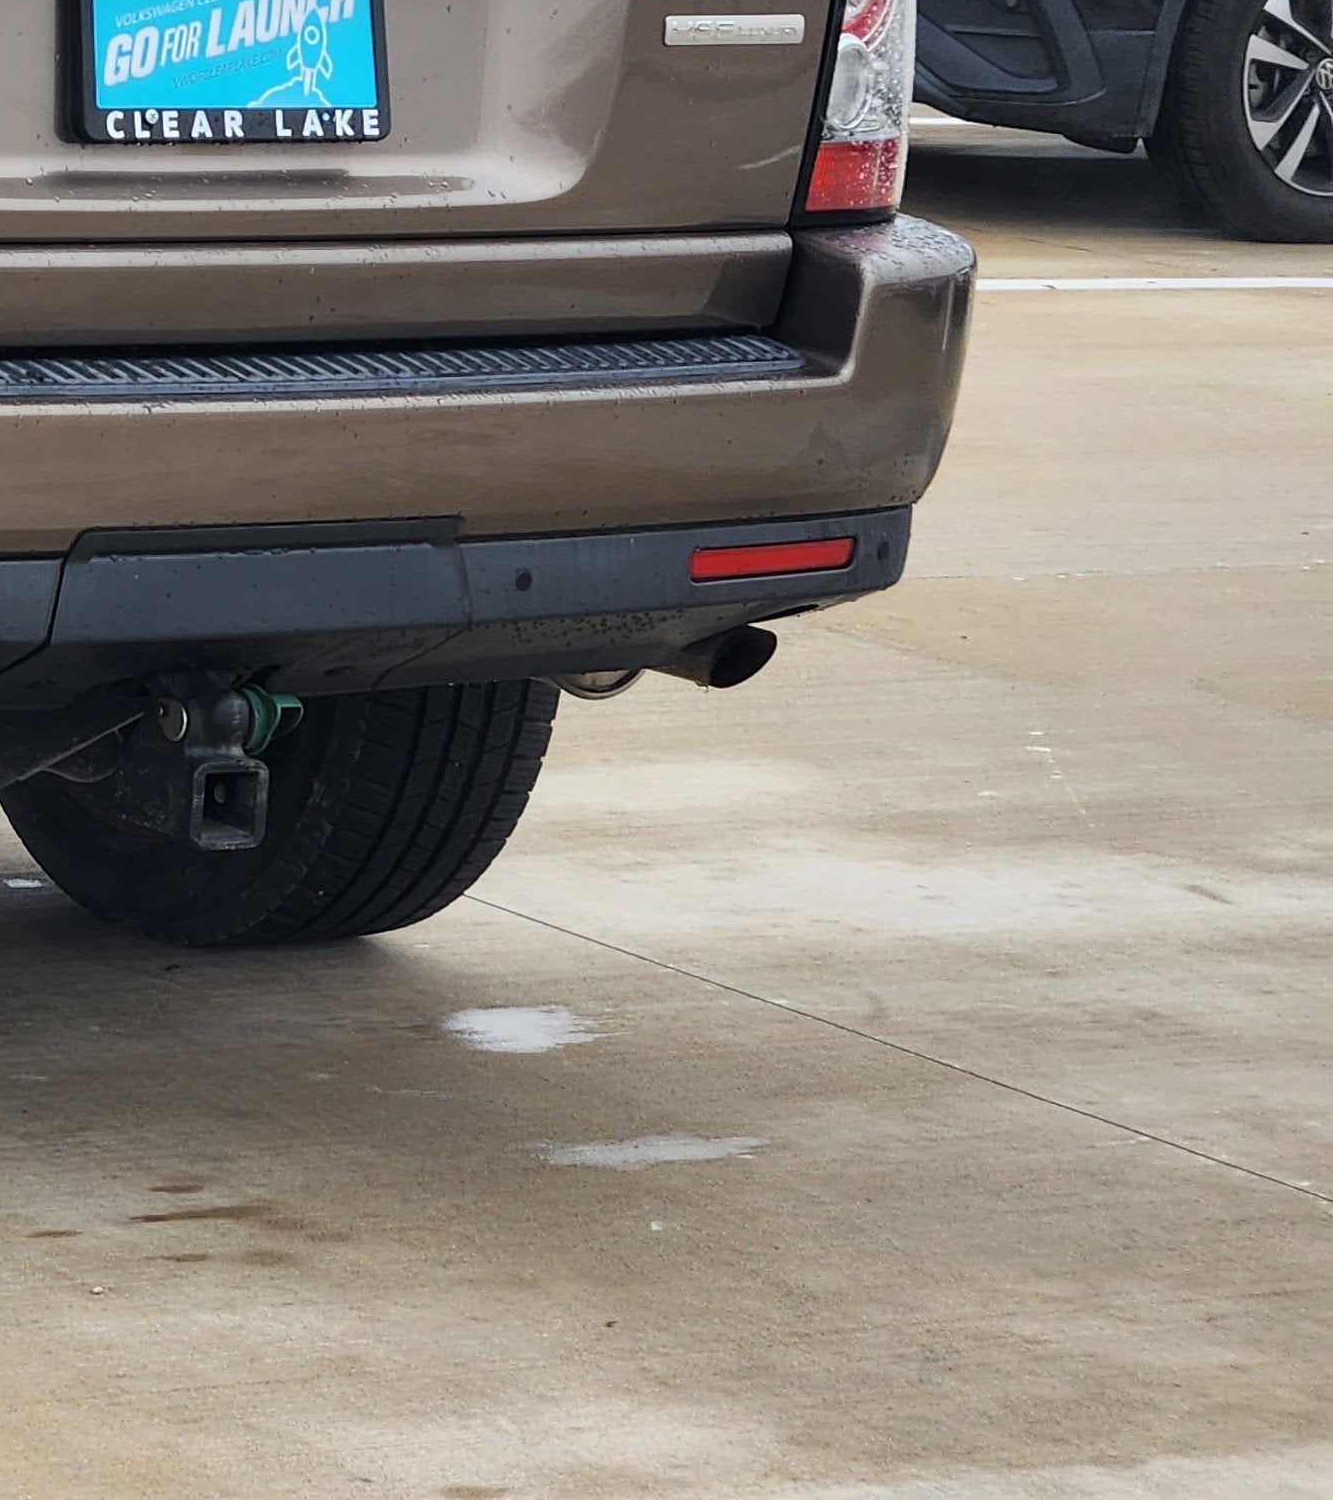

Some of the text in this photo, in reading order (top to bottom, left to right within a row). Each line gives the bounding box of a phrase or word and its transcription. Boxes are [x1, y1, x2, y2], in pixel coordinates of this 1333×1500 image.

[104, 25, 160, 86] GO
[160, 20, 203, 67] FOR
[106, 108, 381, 139] CLEAR LAKE
